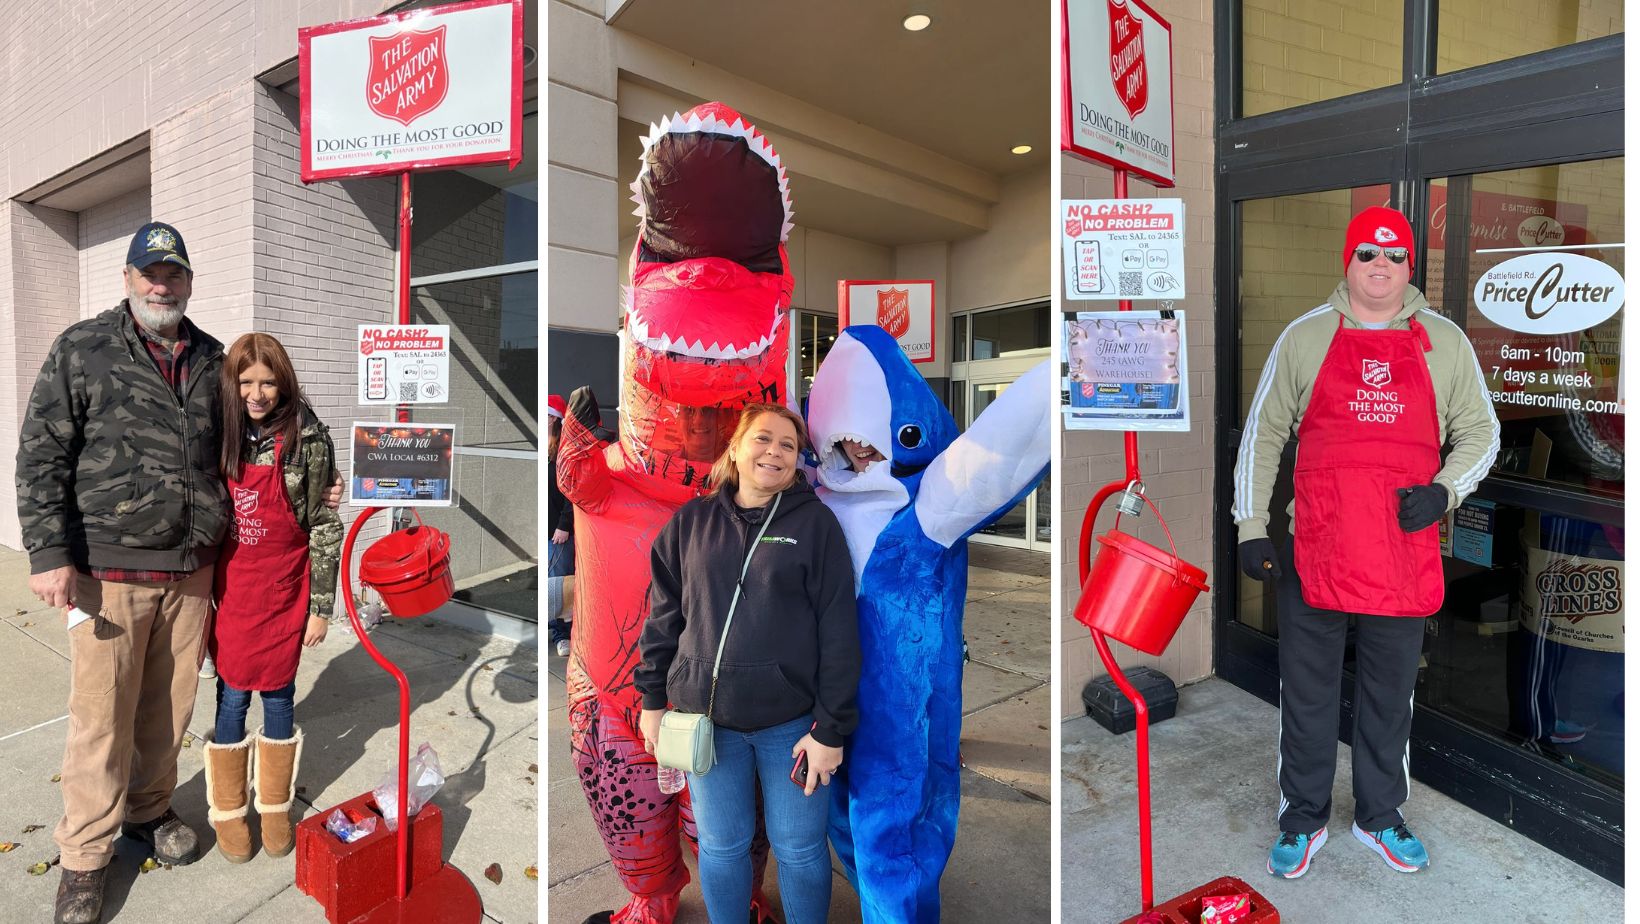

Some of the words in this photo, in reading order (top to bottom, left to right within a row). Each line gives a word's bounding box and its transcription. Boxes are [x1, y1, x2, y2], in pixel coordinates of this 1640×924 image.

[1114, 15, 1130, 43] THE
[382, 37, 412, 70] THE
[1112, 29, 1142, 82] SALVATION
[372, 37, 438, 104] SALVATION
[1126, 61, 1144, 102] ARMY
[396, 66, 436, 114] ARMY
[316, 137, 368, 153] DOING
[372, 133, 401, 146] THE
[404, 127, 448, 144] MOST
[452, 121, 503, 138] GOOD
[1080, 103, 1112, 132] DOING
[1114, 120, 1129, 140] THE
[1131, 128, 1150, 149] MOST
[1151, 138, 1168, 157] GOOD
[1068, 205, 1092, 217] NO
[1098, 204, 1152, 216] CASH?
[1508, 203, 1545, 215] BATTLEFIELD
[1085, 219, 1103, 229] NO
[1107, 218, 1168, 228] PROBLEM
[1488, 272, 1522, 280] Battlefield
[883, 294, 896, 310] THE
[879, 296, 906, 328] SALVATION
[889, 311, 906, 335] ARMY
[363, 329, 382, 339] NO
[386, 329, 428, 338] CASH?
[912, 342, 930, 350] GOOD
[1096, 338, 1131, 356] THANK
[1134, 342, 1152, 354] YOU
[1102, 357, 1115, 365] 245
[1501, 344, 1530, 360] 6am
[1545, 346, 1585, 366] 10pm
[1492, 366, 1500, 380] 7
[1503, 367, 1535, 386] days
[1540, 375, 1548, 384] a
[1553, 372, 1592, 388] week
[1357, 390, 1397, 401] DOING
[1348, 402, 1370, 411] THE
[1374, 402, 1405, 413] MOST
[1358, 413, 1396, 423] GOOD
[378, 434, 413, 449] THANK
[415, 439, 431, 448] YOU
[367, 453, 388, 461] CWA
[230, 532, 259, 545] GOOD
[240, 527, 268, 536] MOST
[1539, 569, 1616, 593] CROSS
[1542, 591, 1618, 613] LINES
[1555, 624, 1574, 633] Council
[1585, 631, 1614, 639] Churches
